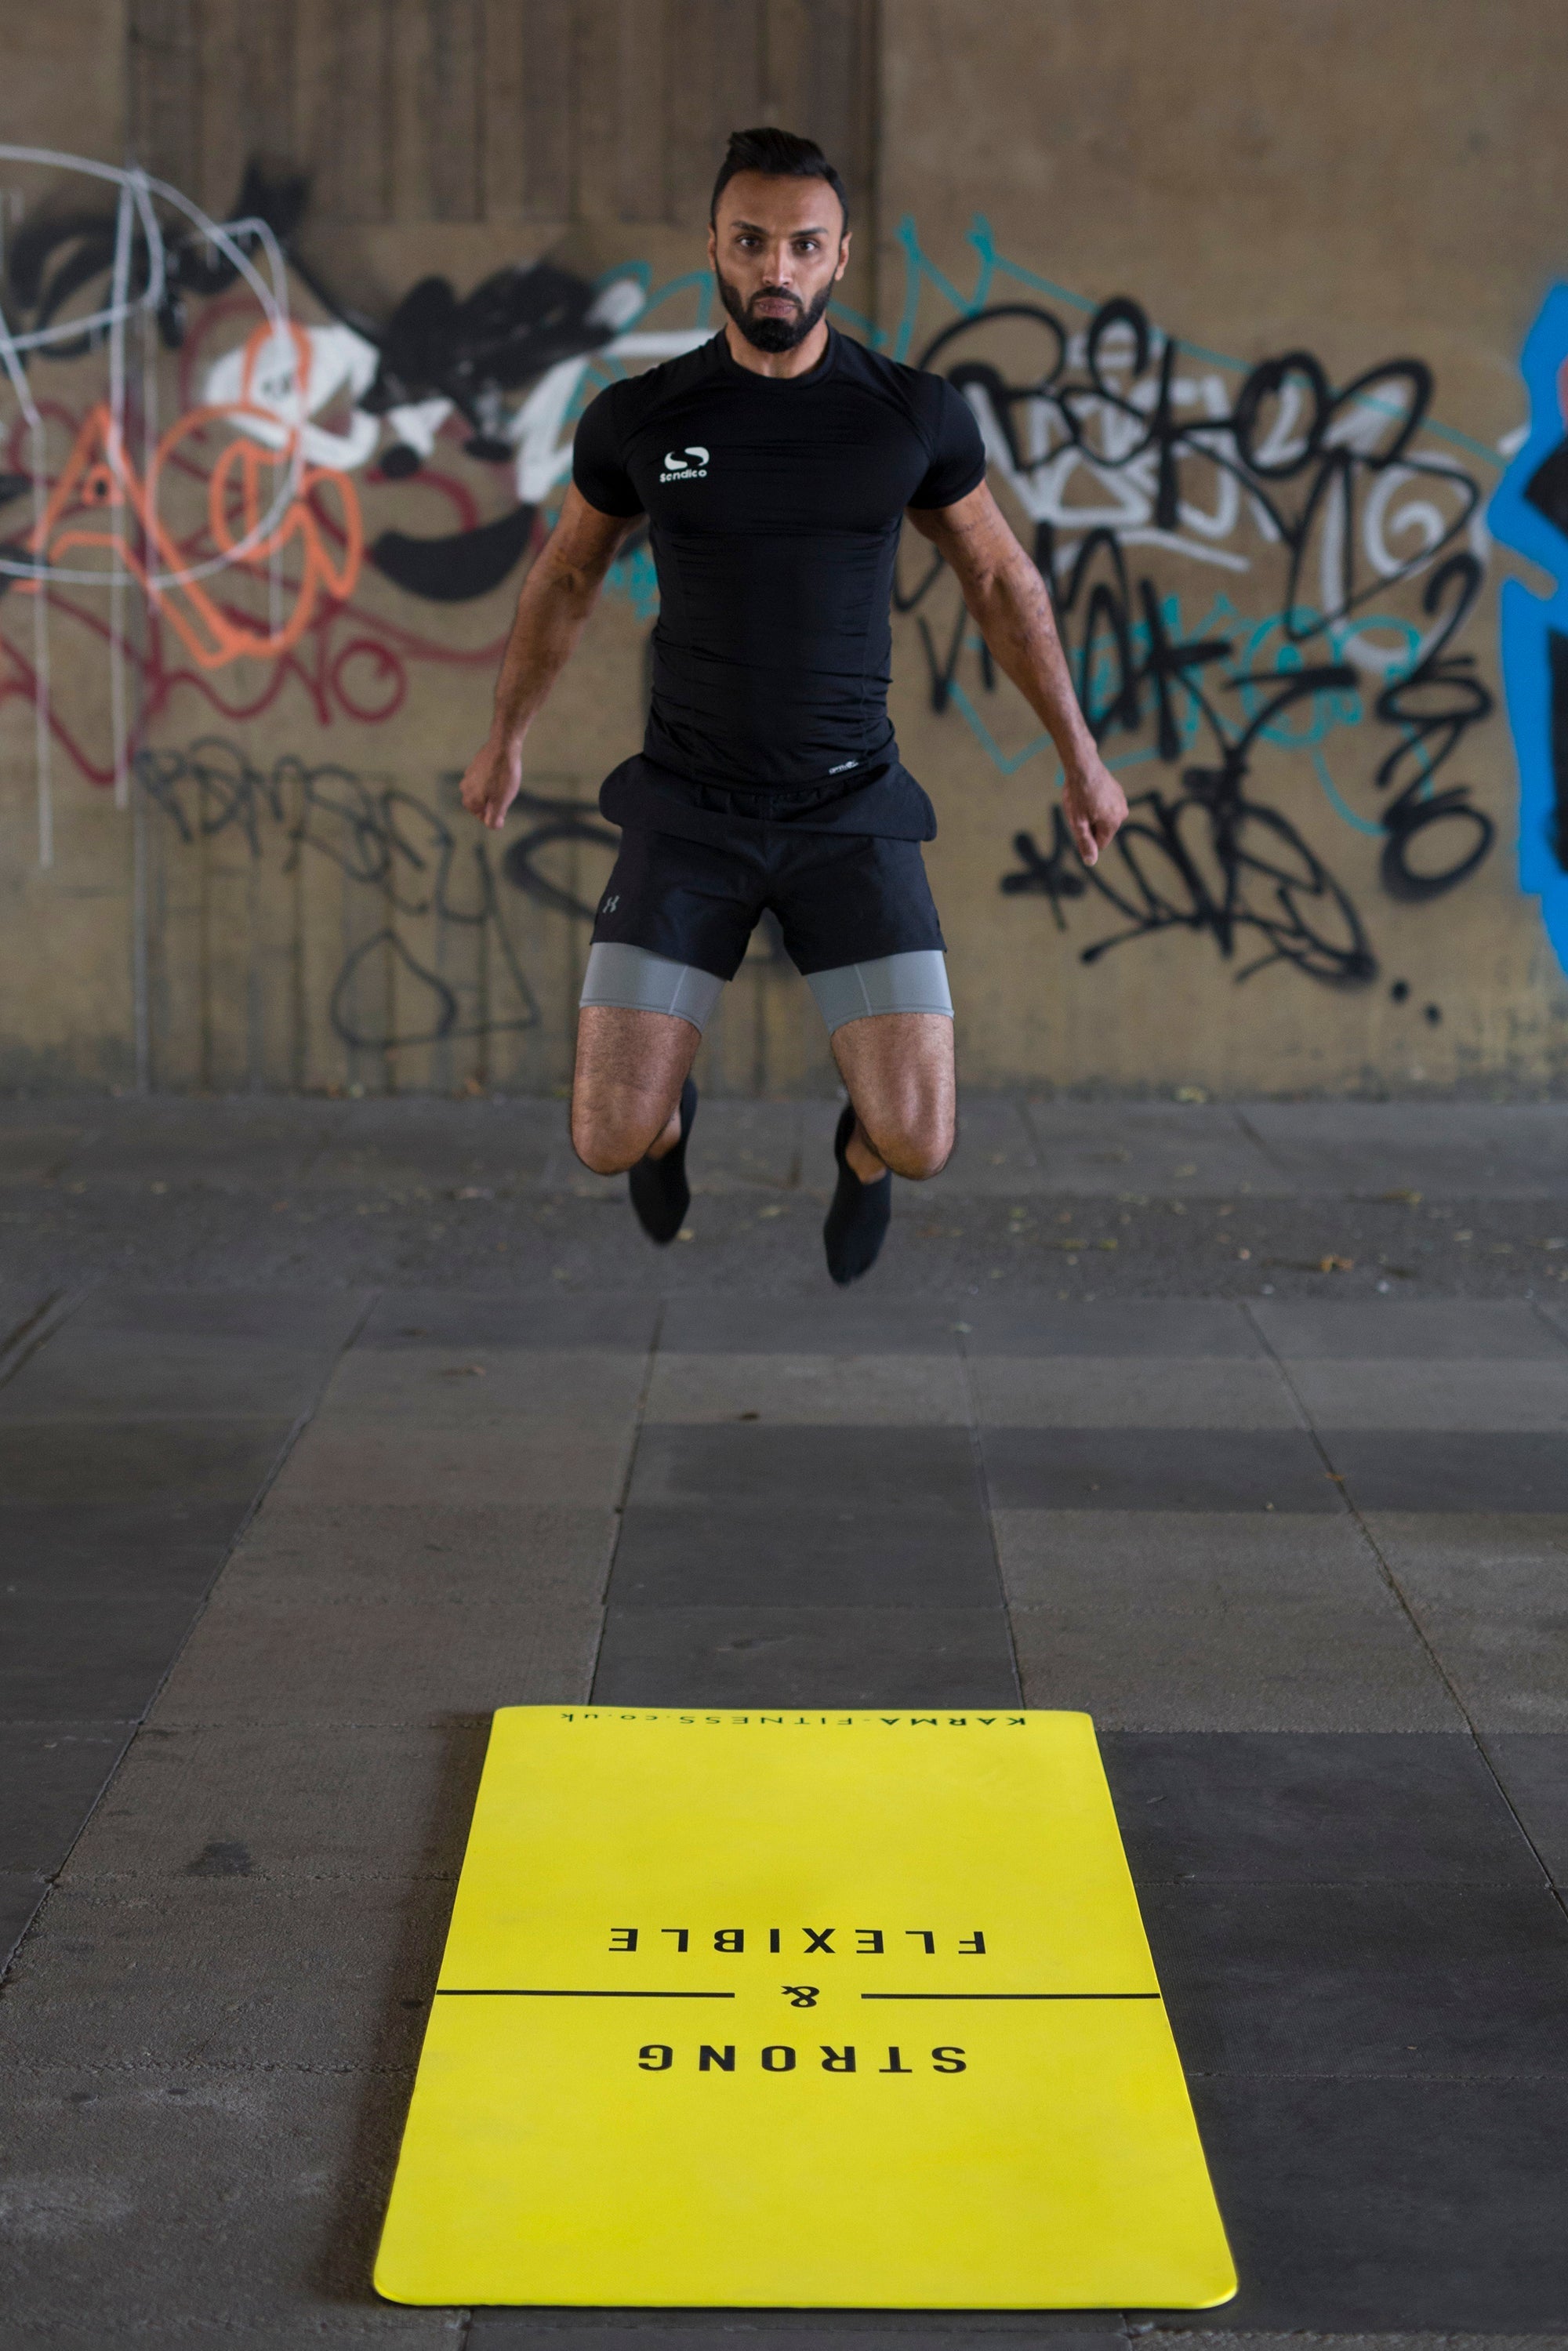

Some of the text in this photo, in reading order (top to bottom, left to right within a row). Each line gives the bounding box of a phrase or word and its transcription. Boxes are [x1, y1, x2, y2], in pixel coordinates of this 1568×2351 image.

[561, 1712, 1027, 1727] KARMA-FITNESS.co.uk
[608, 1928, 986, 1954] FLEXIBLE
[781, 1986, 820, 2008] &
[638, 2044, 967, 2073] STRONG
